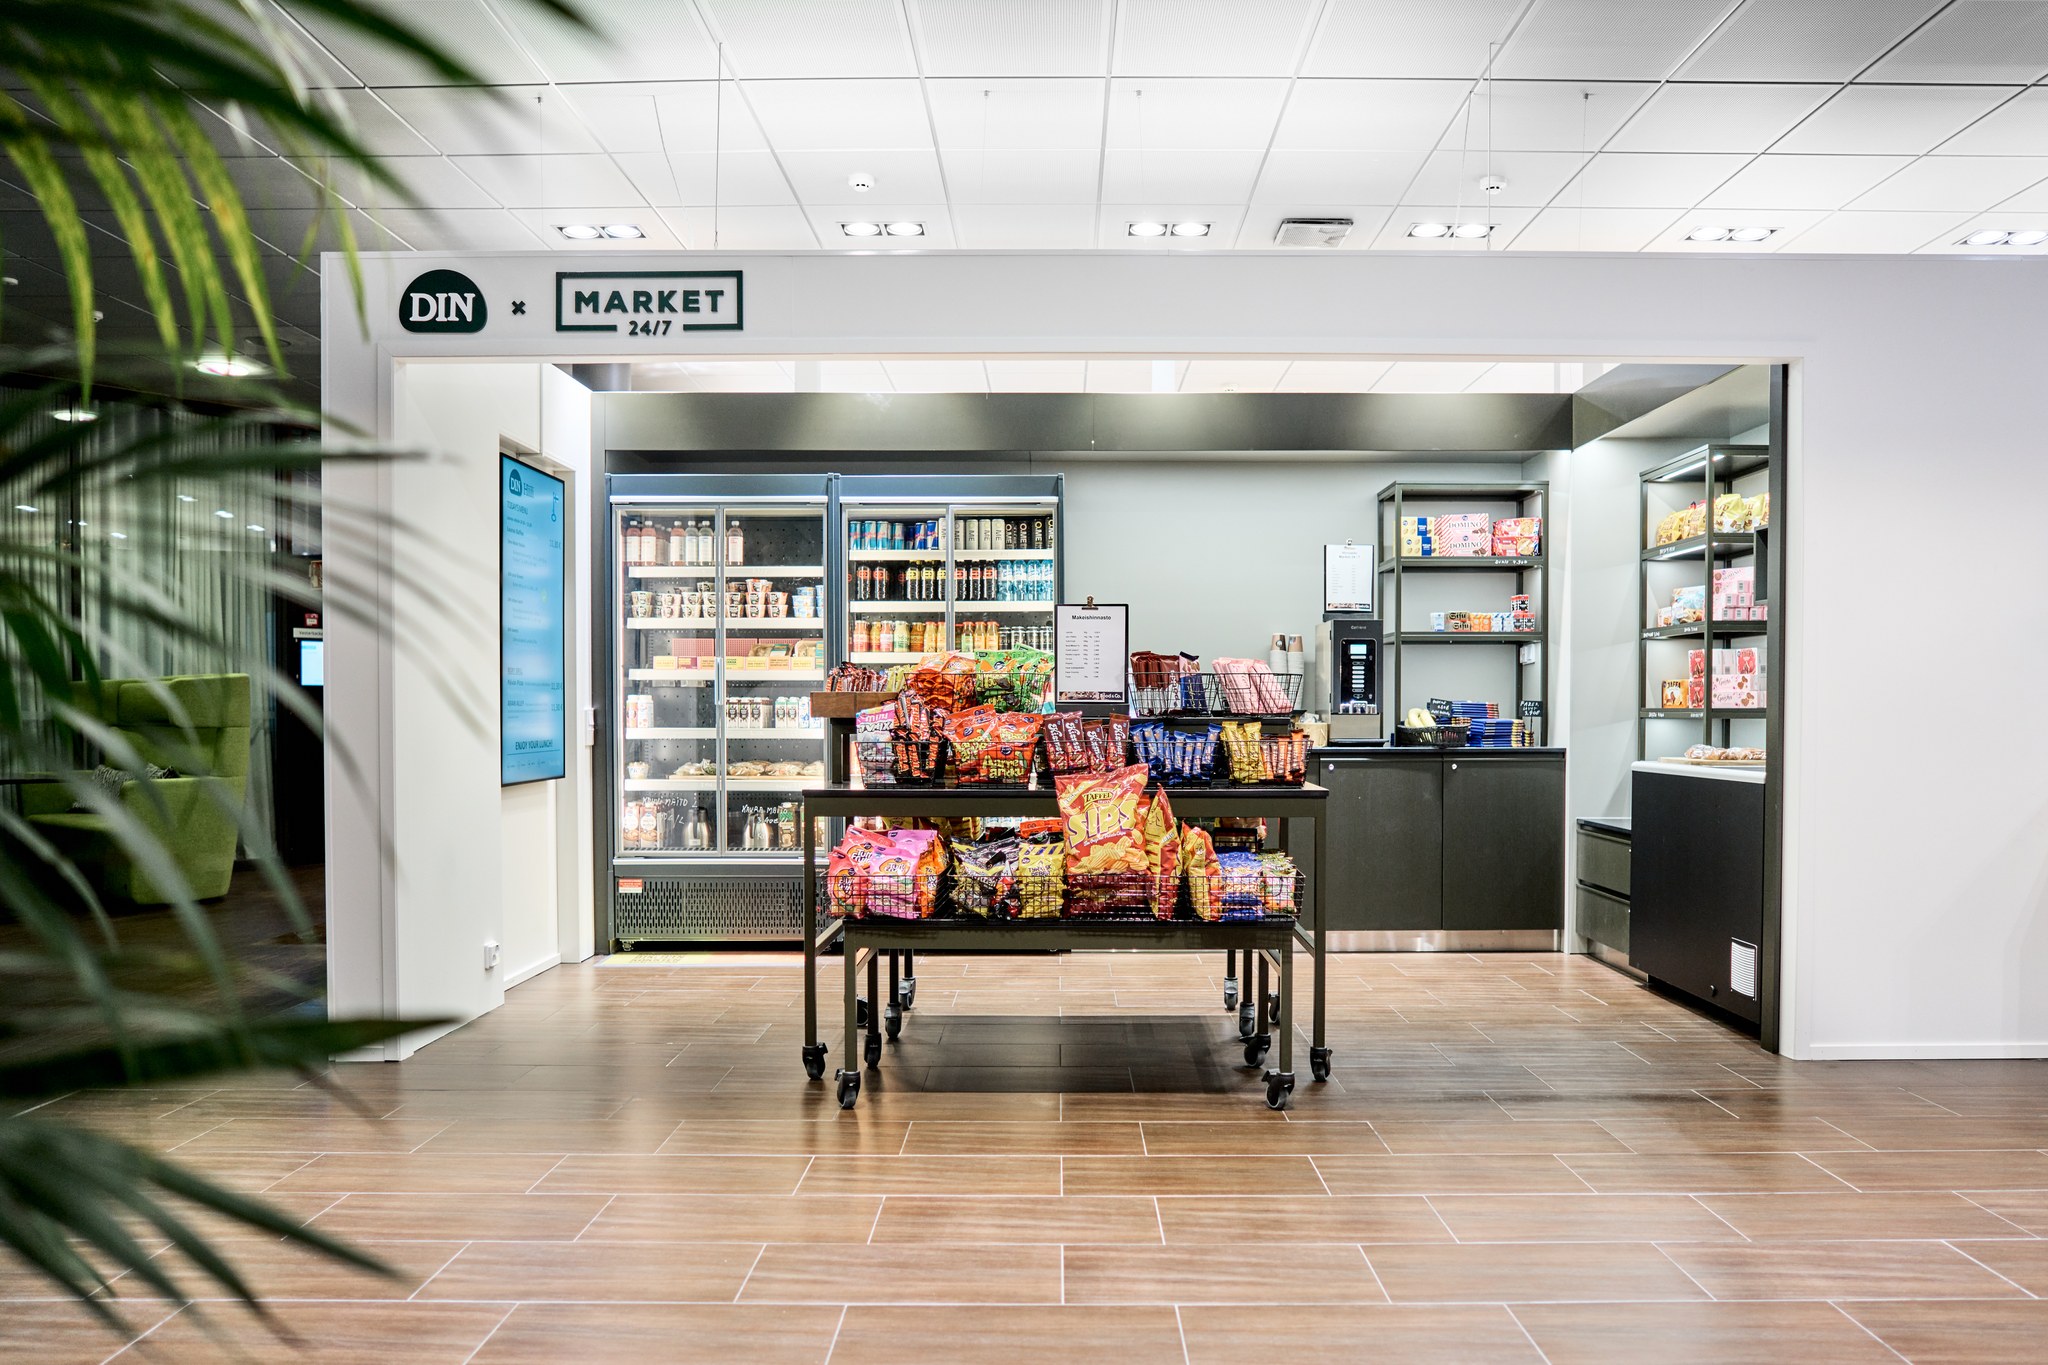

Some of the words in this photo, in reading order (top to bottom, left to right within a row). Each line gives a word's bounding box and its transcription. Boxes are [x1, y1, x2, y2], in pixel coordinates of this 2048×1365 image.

[409, 292, 475, 322] DIN
[574, 290, 725, 314] MARKET
[629, 320, 673, 336] 24/7
[510, 478, 521, 492] DIN
[1448, 520, 1482, 529] DOMINO
[1449, 542, 1482, 550] DOMINO
[866, 713, 889, 722] mini
[515, 741, 528, 751] ENJOY
[528, 740, 539, 749] YOUR
[1083, 792, 1112, 803] TAFFEL
[1068, 800, 1137, 849] SIPS
